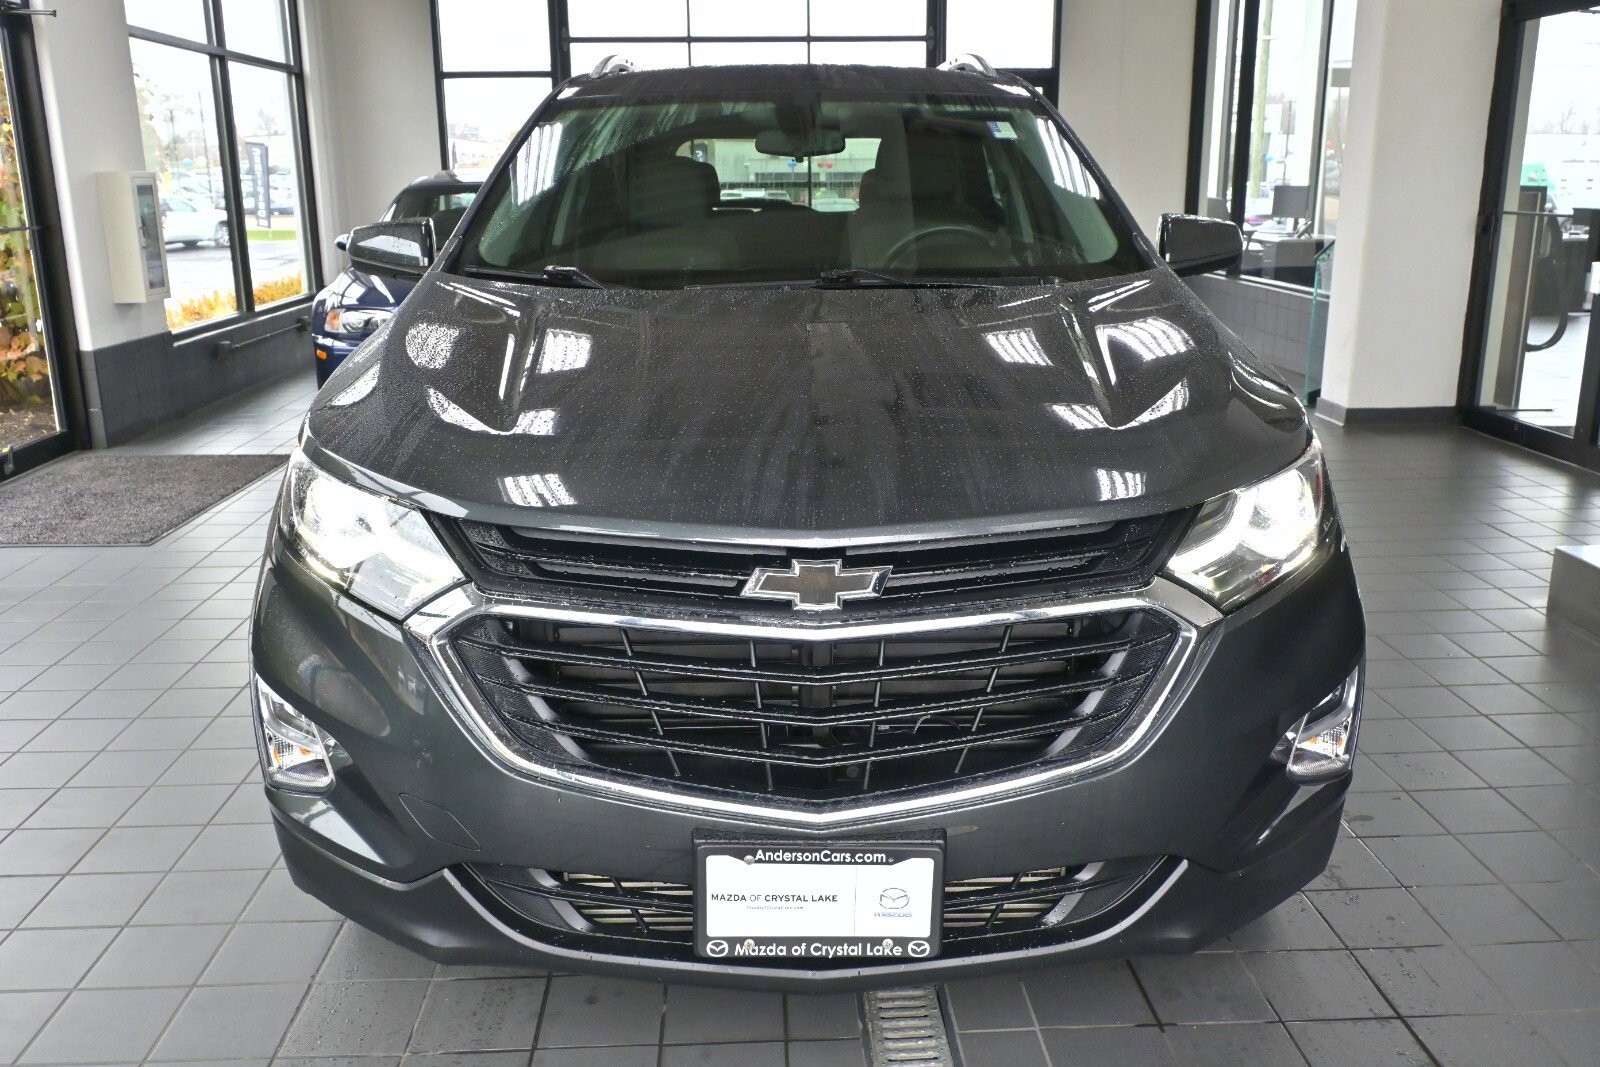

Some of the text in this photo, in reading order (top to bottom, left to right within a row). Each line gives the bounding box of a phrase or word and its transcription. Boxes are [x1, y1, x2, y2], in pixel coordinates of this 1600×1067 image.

[755, 849, 886, 863] AndersonCars.com
[711, 893, 838, 903] MAZDA OF CRYSTAL LAKE
[734, 942, 903, 959] Mazda of Crystal Lake
